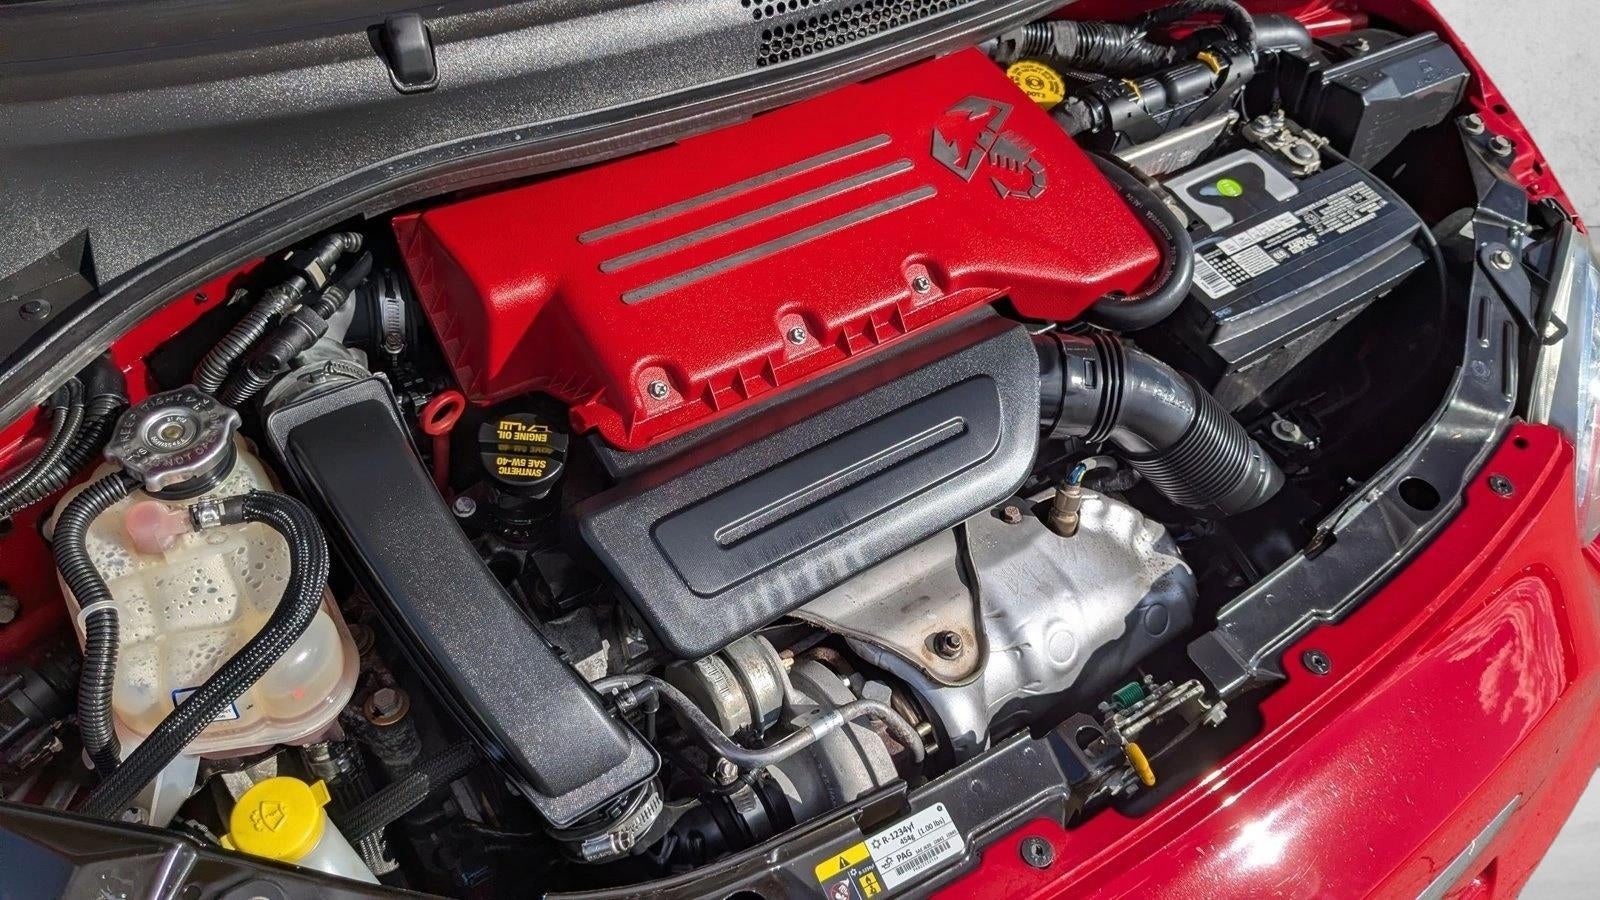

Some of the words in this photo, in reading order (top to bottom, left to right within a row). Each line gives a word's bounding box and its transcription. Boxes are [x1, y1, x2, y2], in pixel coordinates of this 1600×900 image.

[497, 430, 512, 439] OIL
[514, 432, 547, 442] ENGINE
[496, 457, 527, 467] 5W-40
[528, 459, 547, 468] SAE
[498, 466, 543, 477] SYNTHETIC
[882, 822, 915, 844] R-1234yf
[900, 834, 916, 845] 454g
[918, 825, 933, 837] (1.00
[933, 817, 946, 829] lbs)
[896, 849, 913, 863] PAG
